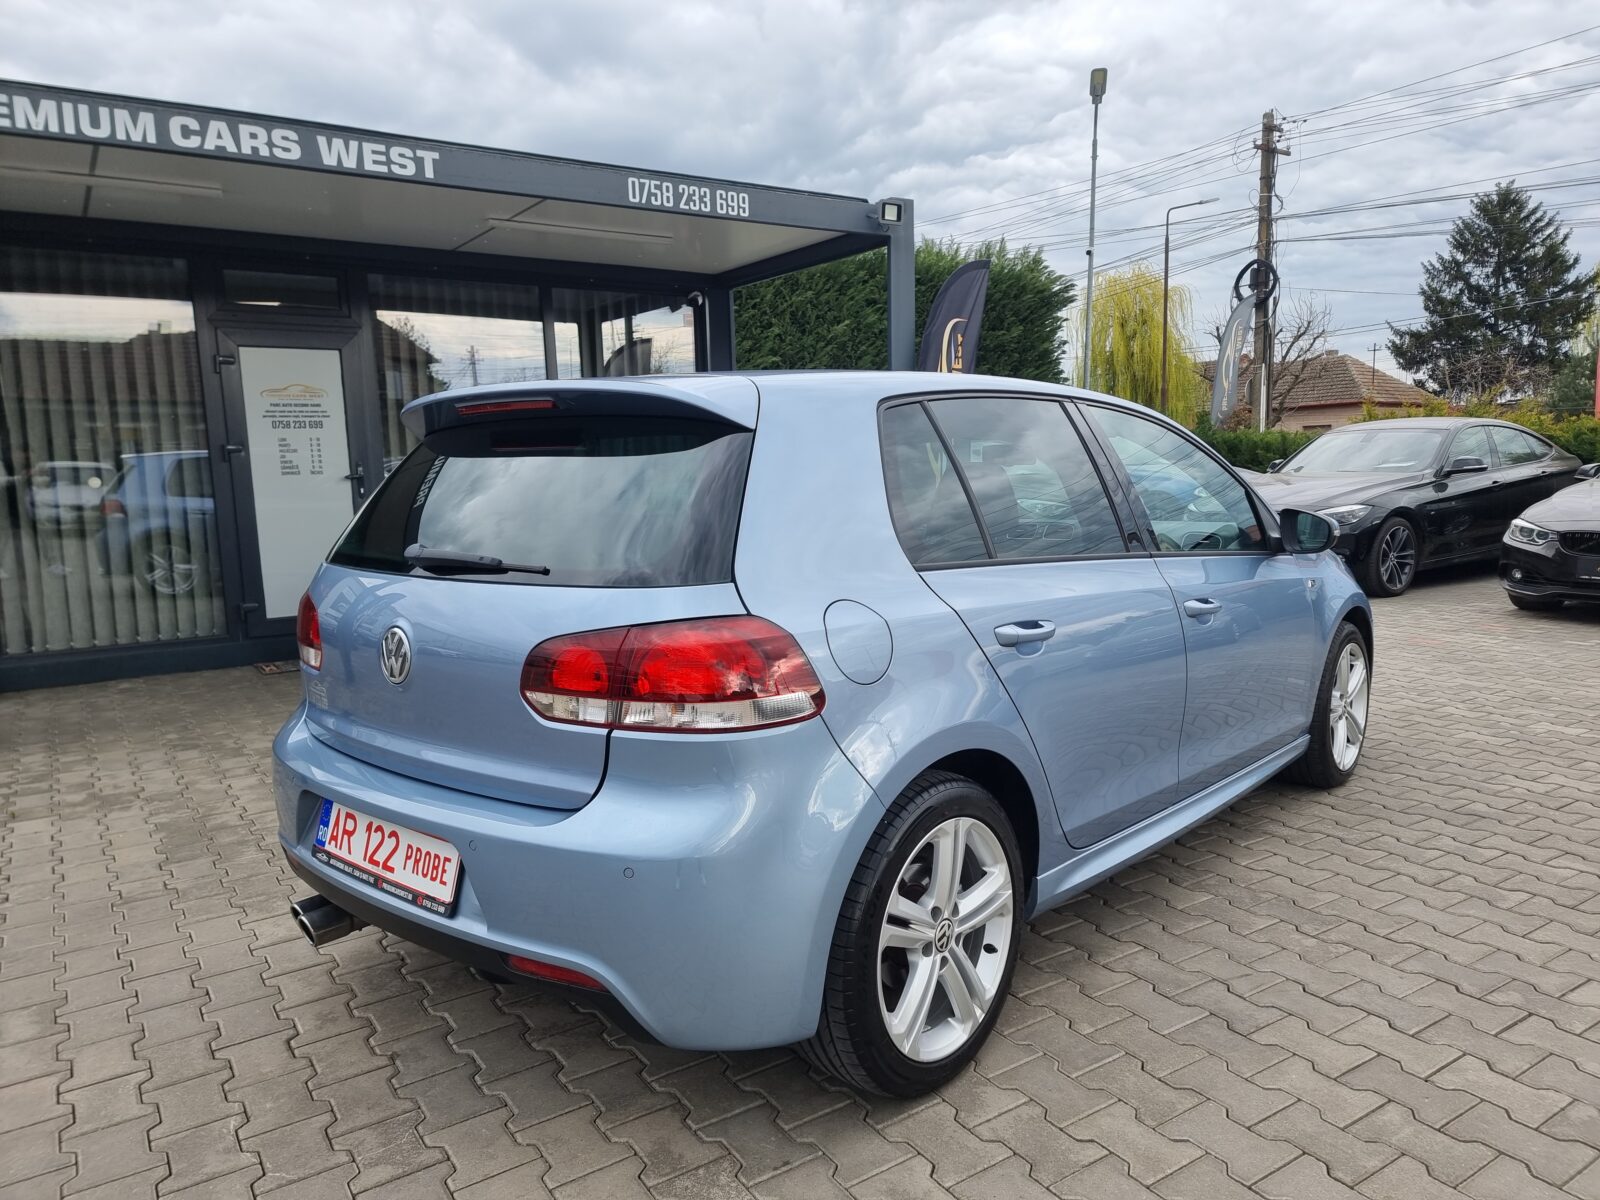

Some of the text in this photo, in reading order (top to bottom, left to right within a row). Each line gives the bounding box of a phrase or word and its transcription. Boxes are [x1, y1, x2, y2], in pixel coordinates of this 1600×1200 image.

[169, 116, 301, 160] CARS
[316, 135, 439, 179] WEST
[627, 177, 749, 217] 0758 233 699
[271, 420, 324, 430] 0758 233 699
[318, 825, 328, 842] RO
[328, 808, 358, 855] AR
[363, 821, 400, 873] 122
[403, 843, 452, 886] PROBE
